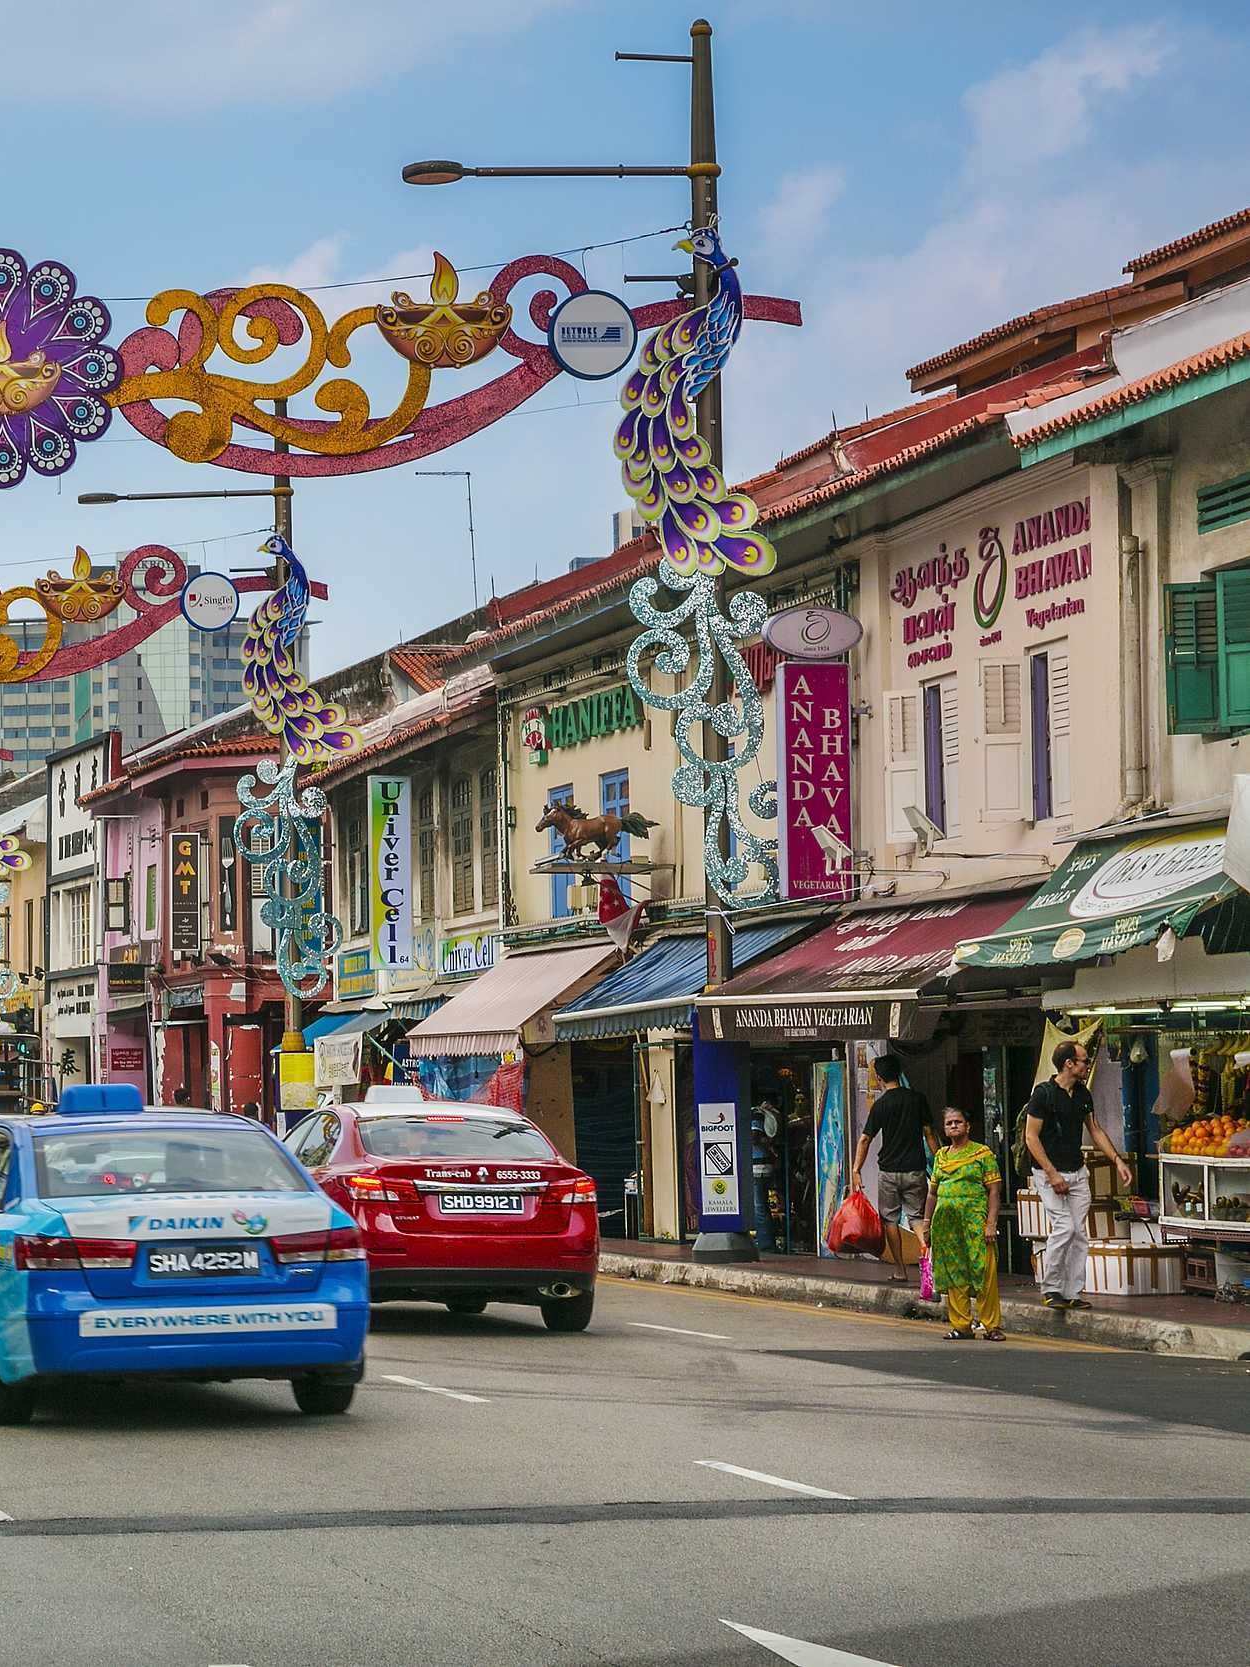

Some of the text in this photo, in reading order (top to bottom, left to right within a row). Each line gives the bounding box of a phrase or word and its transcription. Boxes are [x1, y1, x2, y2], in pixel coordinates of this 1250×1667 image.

[1014, 543, 1092, 600] BHAVAN
[1025, 597, 1085, 630] Vegetarian
[791, 674, 815, 829] ANANDA
[820, 708, 845, 853] BHAVA
[174, 840, 196, 895] GMT
[378, 781, 404, 964] Univer Cell
[399, 956, 410, 965] 64
[441, 942, 473, 973] Univer
[474, 935, 495, 967] Cell
[735, 1006, 874, 1028] ANANDA BHAVAN VEGETARIAN
[701, 1124, 734, 1132] BIGFOOT
[424, 1168, 472, 1179] Trans-cab
[496, 1170, 541, 1180] 6555-3333
[444, 1195, 520, 1209] SHD9912T
[149, 1216, 225, 1231] DAIKIN
[150, 1250, 259, 1273] SHA4252M
[94, 1310, 324, 1329] EVERYWHERE WITH YOU
